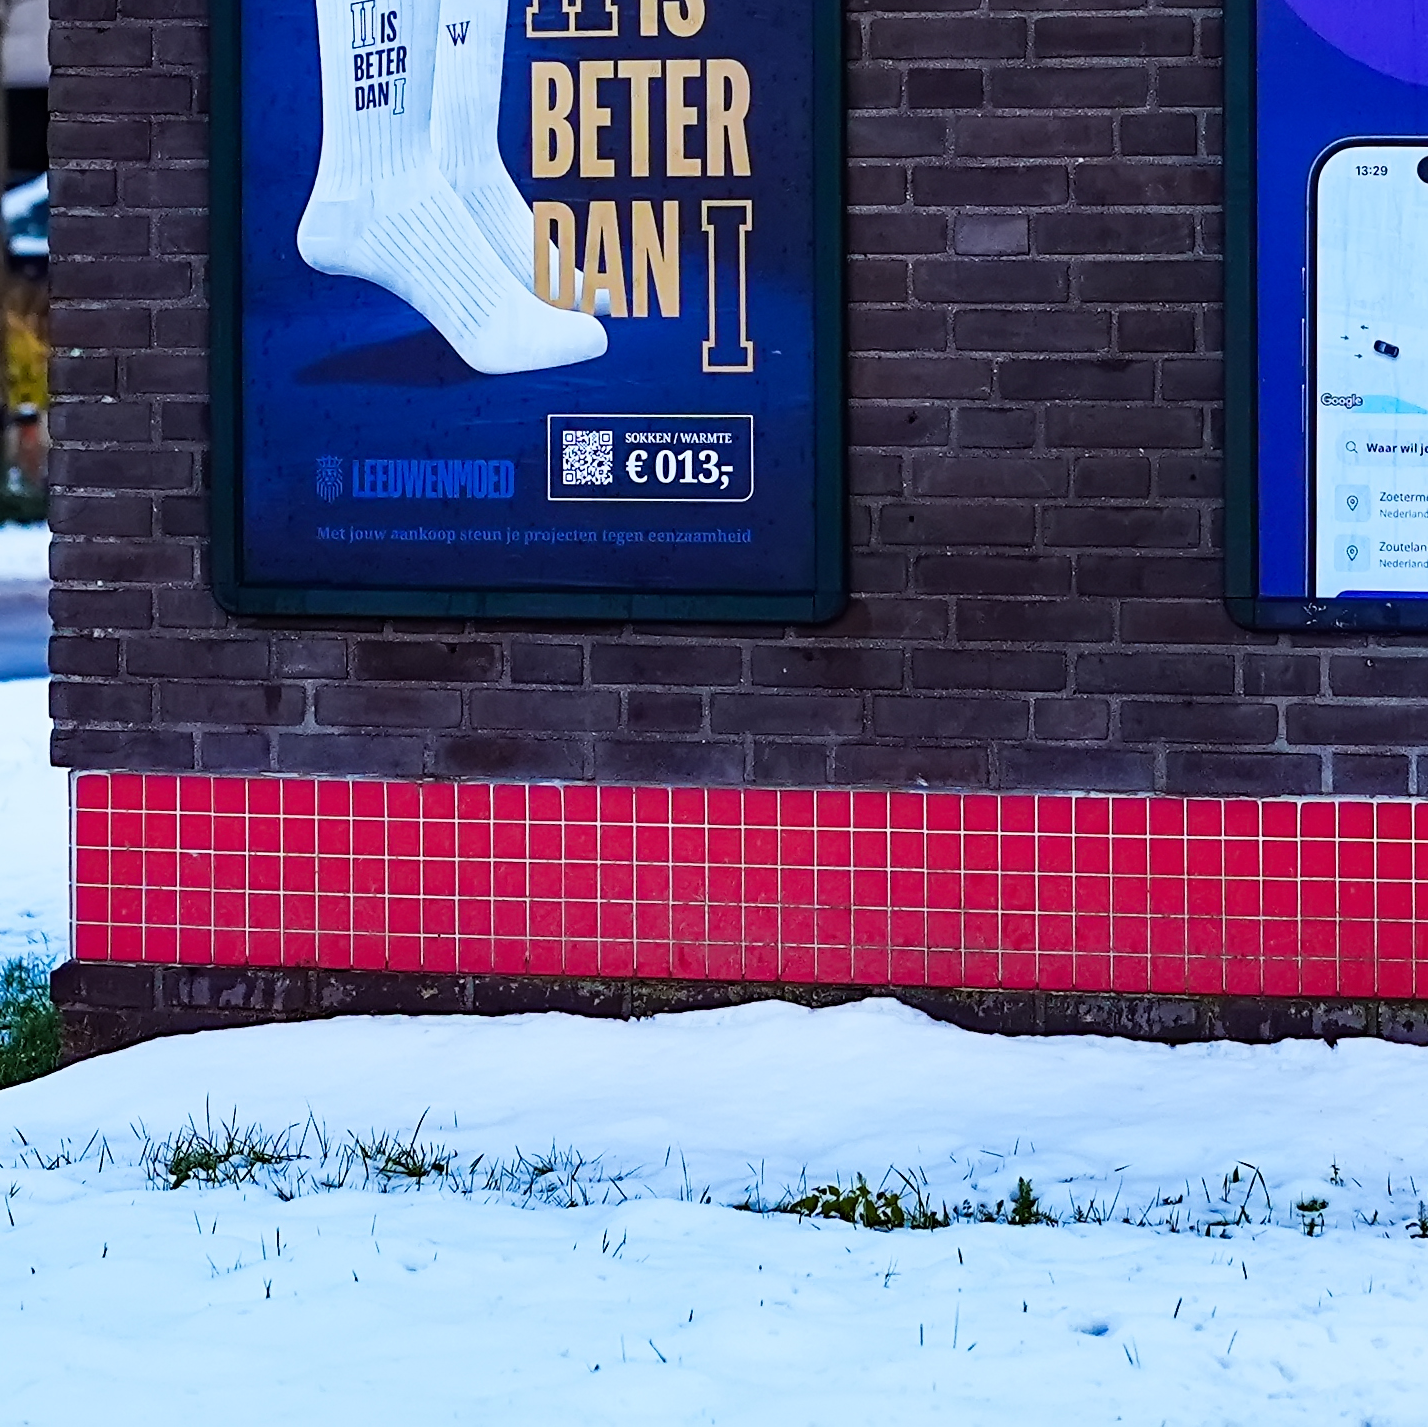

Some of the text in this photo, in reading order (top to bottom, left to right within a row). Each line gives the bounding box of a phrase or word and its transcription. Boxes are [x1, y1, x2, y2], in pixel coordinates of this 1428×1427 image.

[380, 10, 398, 44] IS
[445, 20, 471, 47] W
[353, 45, 408, 82] BETER
[354, 77, 407, 116] DAN I
[530, 59, 752, 179] BETER
[1355, 165, 1388, 176] 13:29
[531, 199, 755, 373] DAN I
[1320, 393, 1363, 409] Google
[625, 432, 672, 444] SOKKEN
[680, 432, 733, 444] WARMTE
[1366, 442, 1398, 454] Waar
[1400, 442, 1418, 454] wil
[352, 459, 514, 499] LEEUWENMOED
[625, 449, 649, 484] €
[316, 526, 752, 547] Met jouw aankoop steun je projecten tegen eenzaamheid
[1379, 559, 1428, 569] Nederland
